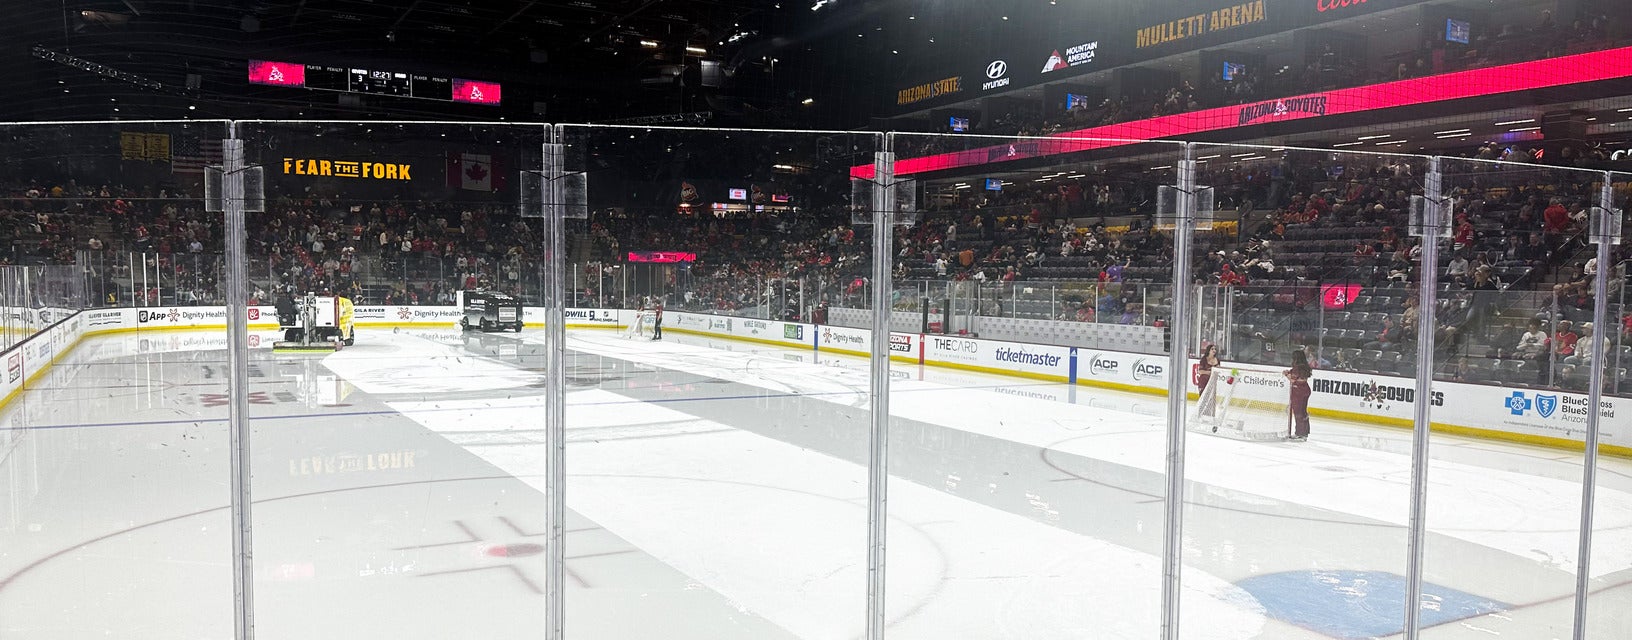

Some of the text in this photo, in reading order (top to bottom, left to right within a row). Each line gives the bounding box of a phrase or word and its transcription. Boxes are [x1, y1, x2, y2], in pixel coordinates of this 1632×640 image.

[1136, 0, 1264, 49] MULLETT ARENA
[1066, 41, 1098, 56] MOUNTAIN
[1067, 50, 1095, 63] AMERICA
[373, 71, 390, 79] 12:27
[897, 76, 960, 105] ARIZONA STATE
[982, 77, 1010, 91] HYUNDAI
[1238, 96, 1327, 126] ARIZONA COYOTES
[283, 158, 411, 180] FEAR THE FORK
[182, 311, 205, 320] Dignity
[414, 310, 439, 318] Dignity
[565, 310, 587, 318] DWILL
[833, 332, 848, 344] Dignity
[890, 343, 909, 352] PORTS
[995, 347, 1061, 367] ticketmaster
[1094, 359, 1118, 369] ACP
[1137, 363, 1163, 375] ACP
[1244, 376, 1284, 388] Children's
[1312, 378, 1445, 407] ARIZONA COYOS
[1562, 395, 1613, 408] BlueCoss
[1561, 405, 1615, 419] BlueSield
[1561, 414, 1588, 424] Arizon
